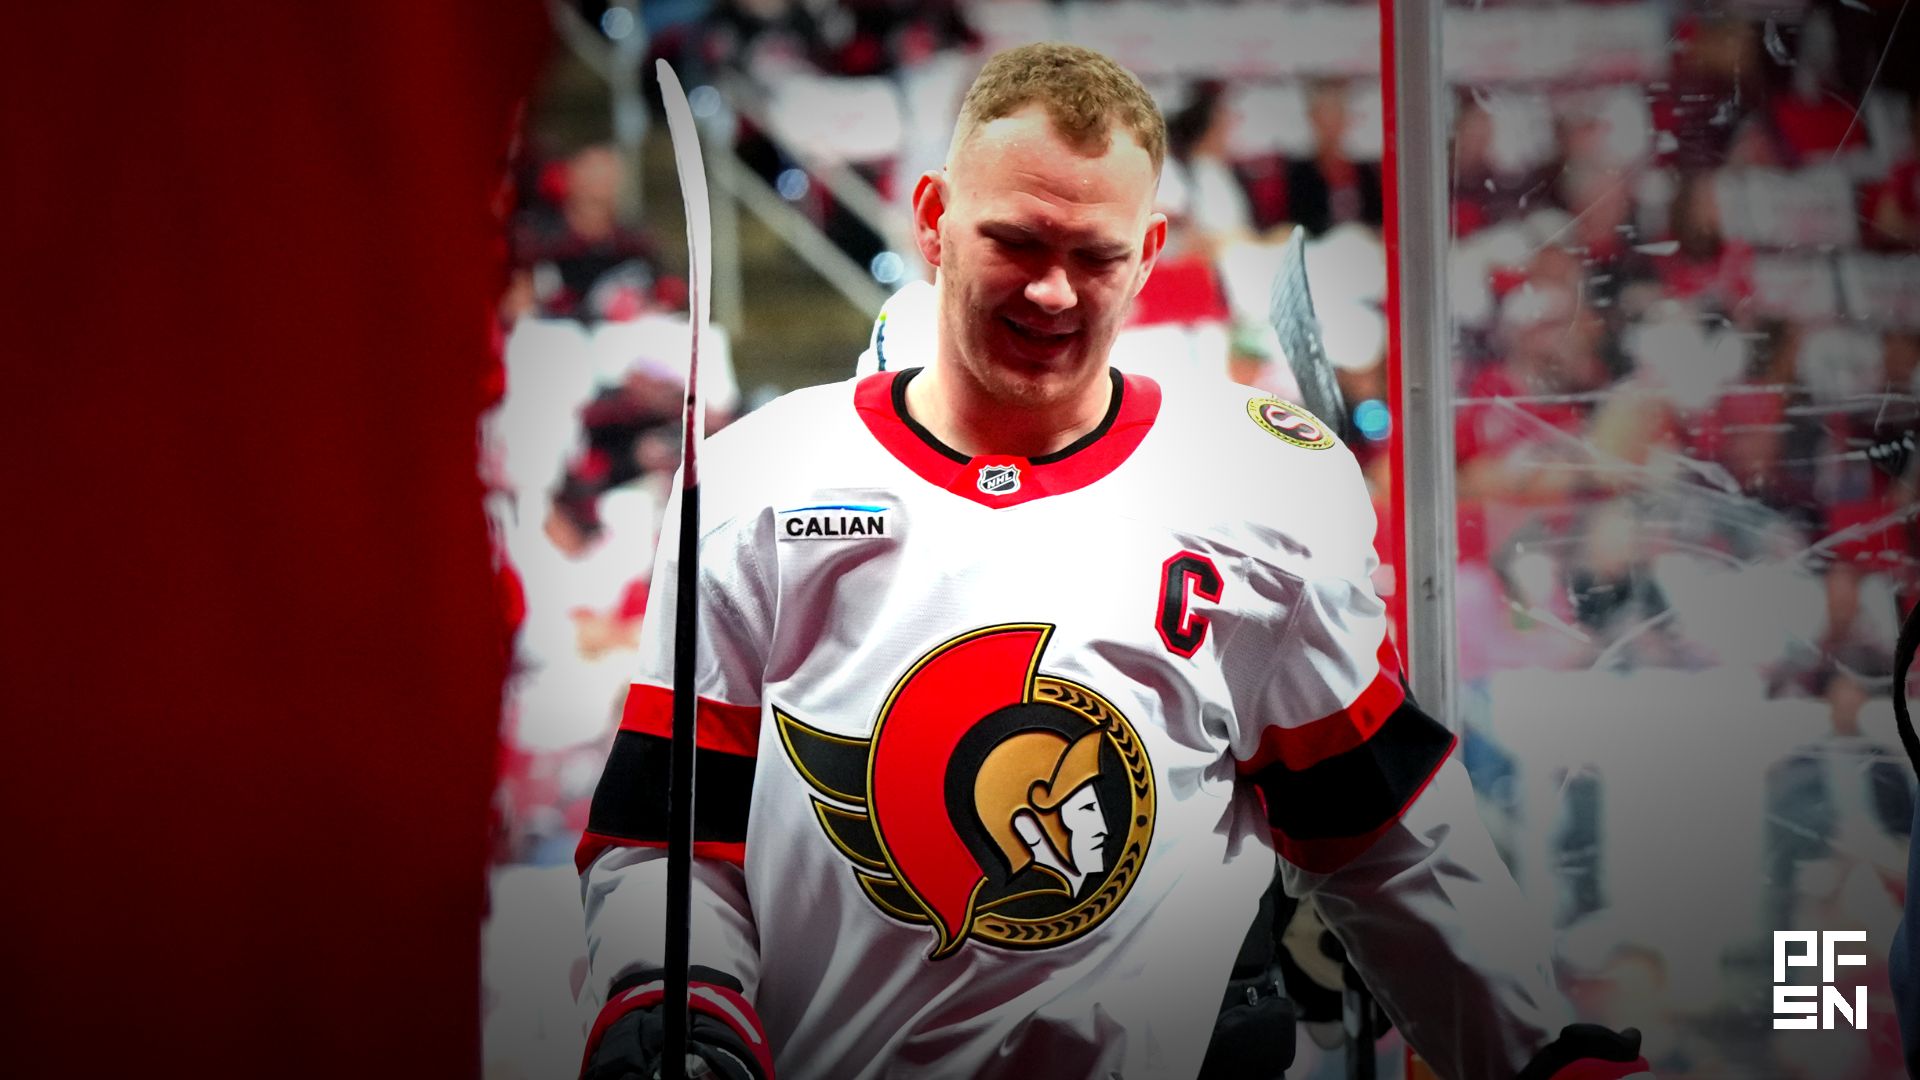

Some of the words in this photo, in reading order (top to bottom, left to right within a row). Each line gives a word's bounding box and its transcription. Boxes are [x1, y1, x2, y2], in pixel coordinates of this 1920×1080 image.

[987, 473, 1012, 489] NHL
[786, 516, 884, 536] CALIAN
[1155, 550, 1224, 660] C
